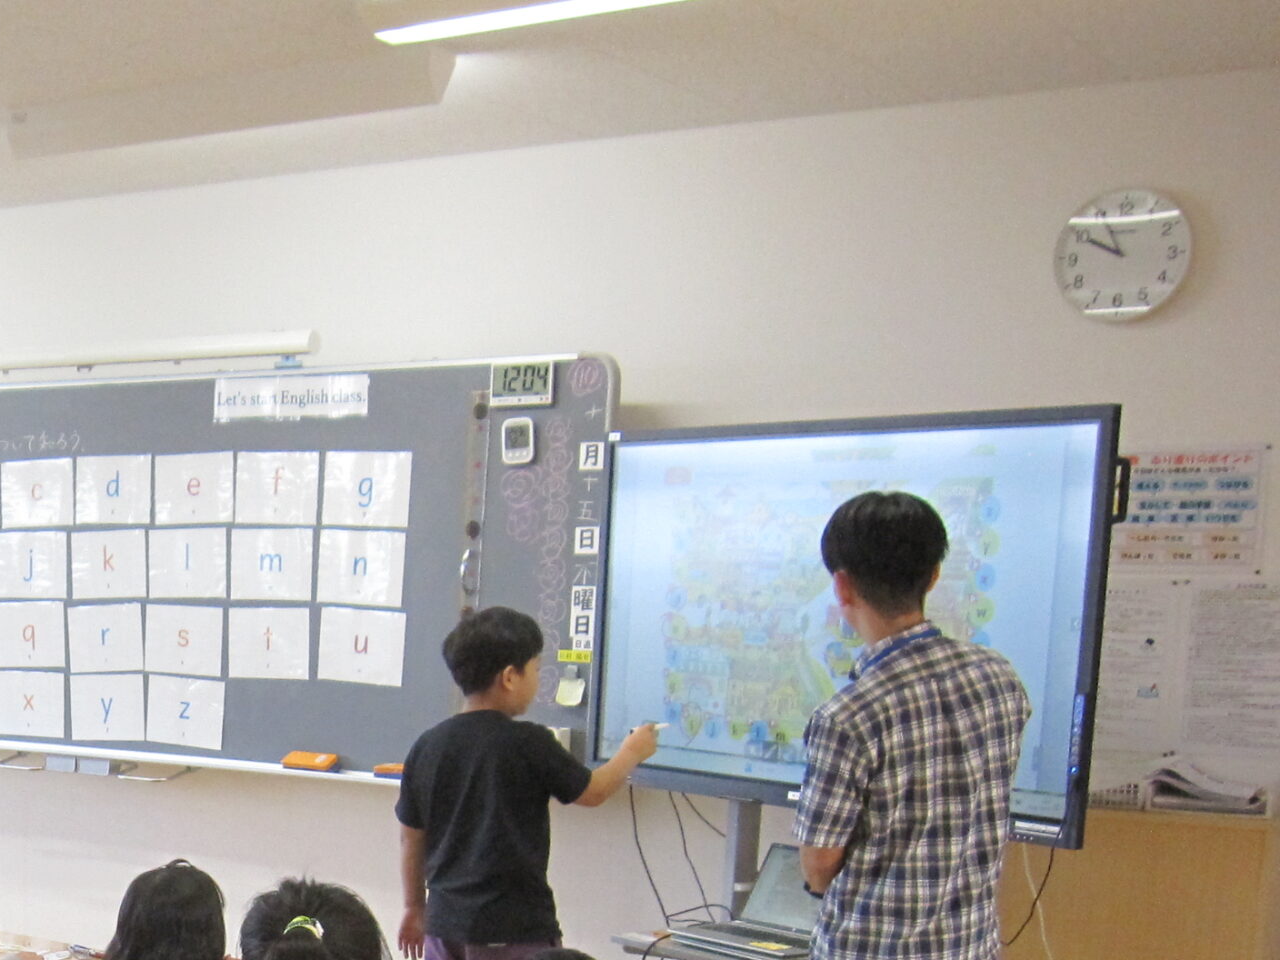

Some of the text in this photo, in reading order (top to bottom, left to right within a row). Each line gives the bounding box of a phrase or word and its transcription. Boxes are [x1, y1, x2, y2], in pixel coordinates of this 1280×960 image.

[1119, 201, 1134, 215] 12
[1075, 229, 1090, 243] 10
[1161, 222, 1172, 236] 2
[1067, 253, 1078, 267] 9
[1167, 245, 1178, 260] 3
[1073, 274, 1084, 289] 8
[1157, 269, 1167, 283] 4
[1092, 290, 1100, 304] 7
[1112, 293, 1123, 308] 6
[1138, 287, 1148, 301] 5
[217, 391, 246, 406] Let's
[280, 387, 329, 408] English
[331, 387, 366, 403] class.
[30, 483, 43, 500] c
[106, 470, 120, 497] d
[186, 477, 201, 497] e
[271, 466, 285, 496] f
[357, 477, 373, 508] g
[22, 548, 33, 583] j
[102, 545, 115, 572] k
[259, 553, 283, 573] m
[352, 557, 367, 576] n
[22, 624, 36, 651] q
[100, 628, 110, 646] r
[177, 628, 190, 648] s
[353, 634, 369, 655] u
[23, 694, 34, 711] x
[100, 697, 113, 724] y
[178, 701, 191, 720] z
